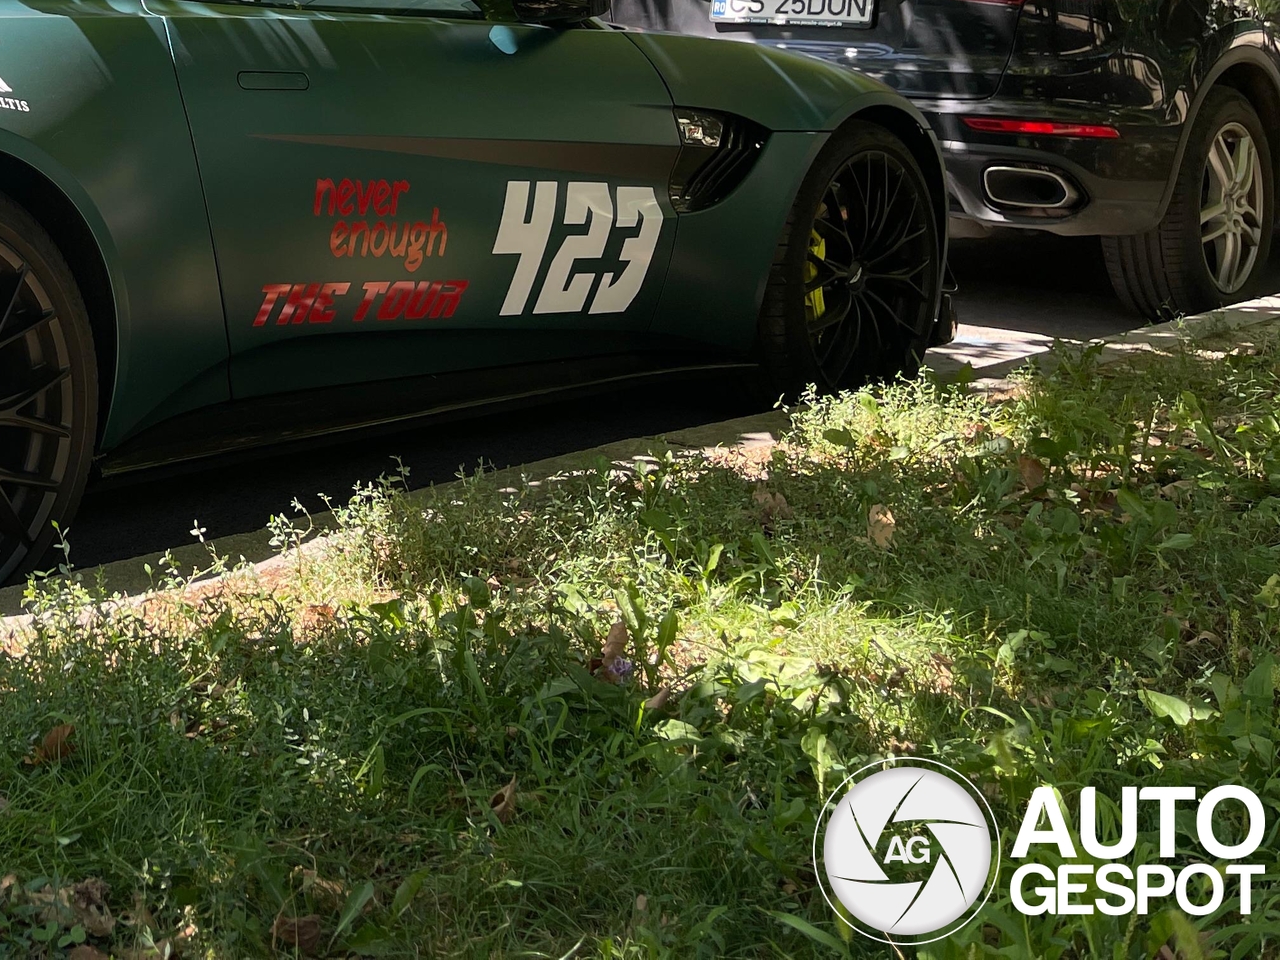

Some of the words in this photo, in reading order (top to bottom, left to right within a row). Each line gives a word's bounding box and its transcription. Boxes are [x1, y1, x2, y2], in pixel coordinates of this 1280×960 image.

[714, 1, 726, 14] RO
[313, 177, 411, 217] never
[329, 207, 448, 273] enough
[491, 180, 664, 316] 423
[252, 281, 351, 327] THE
[353, 279, 469, 323] TOUR
